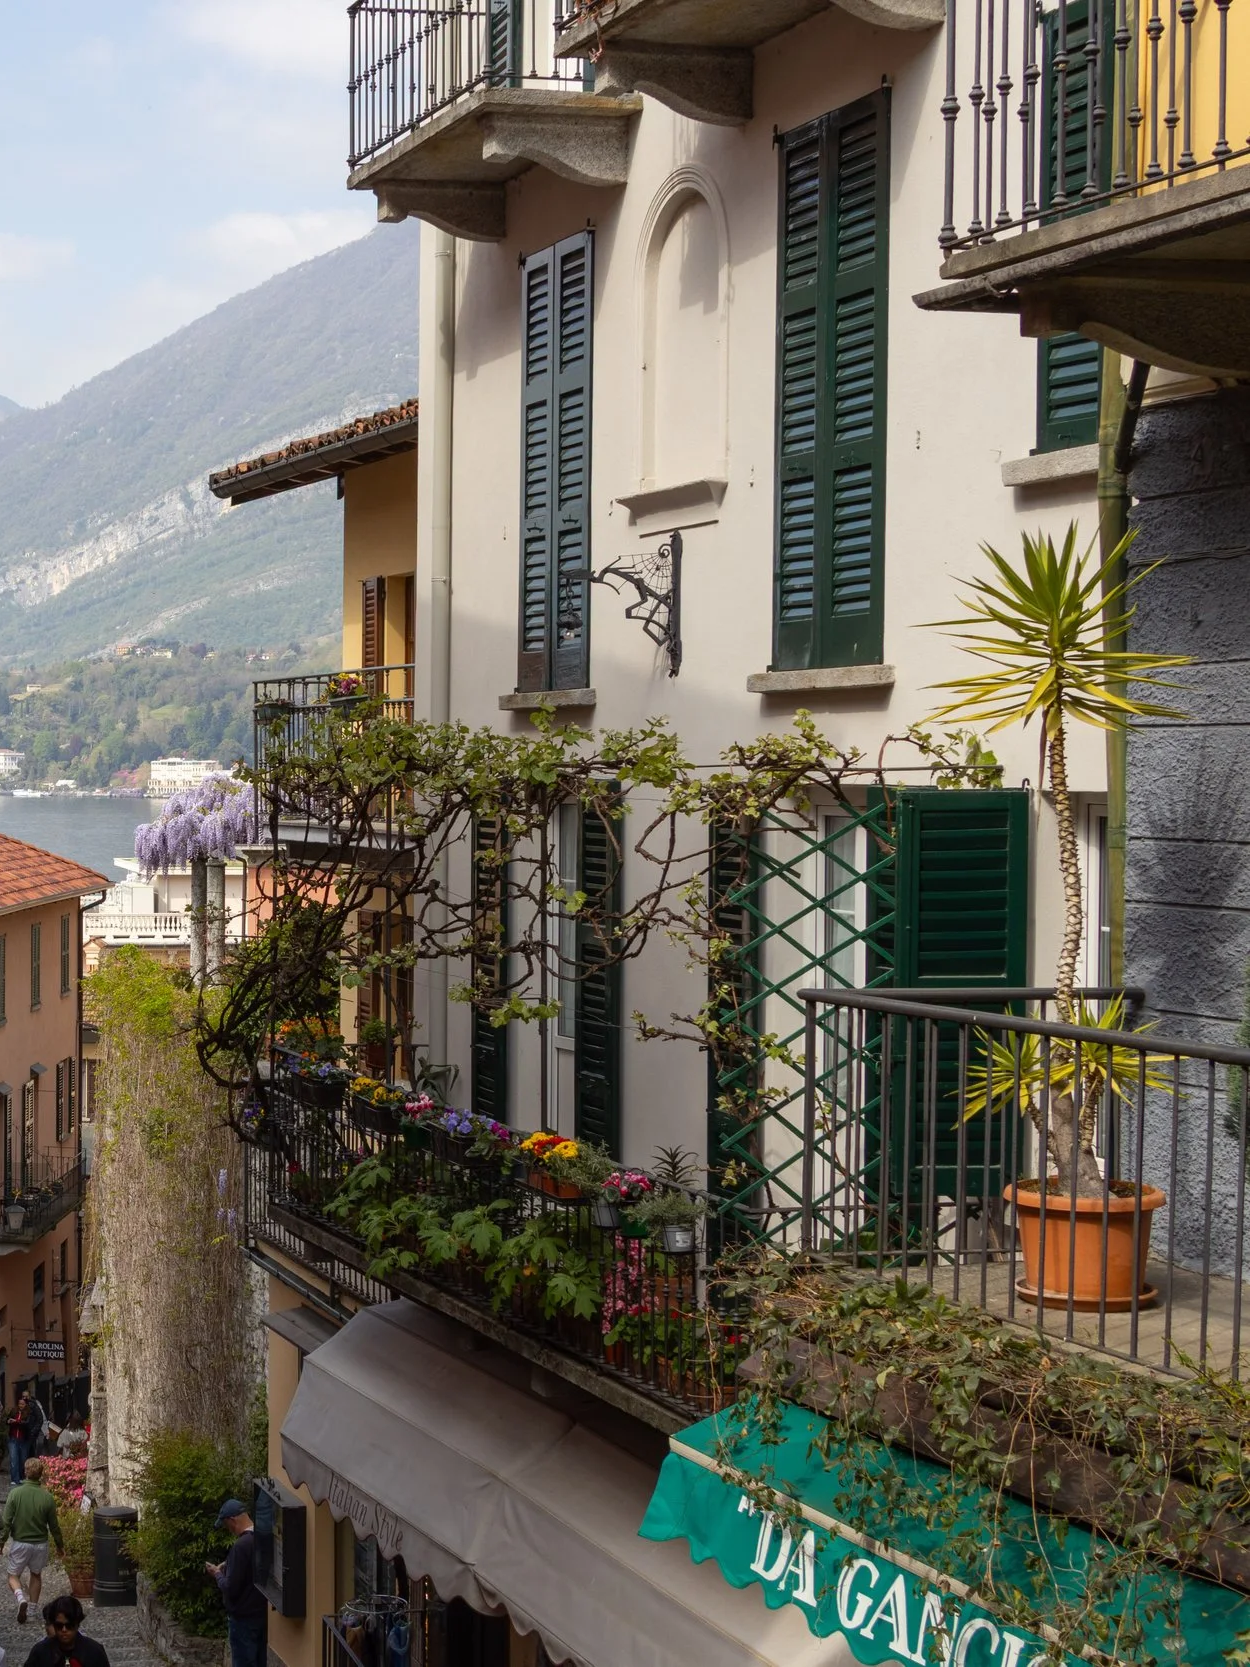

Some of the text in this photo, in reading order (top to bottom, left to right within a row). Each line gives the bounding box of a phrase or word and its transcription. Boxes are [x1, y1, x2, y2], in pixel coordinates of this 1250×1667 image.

[27, 1342, 65, 1350] CAROLINA
[27, 1350, 65, 1358] BOUTIQUE
[327, 1471, 404, 1553] Italian Style
